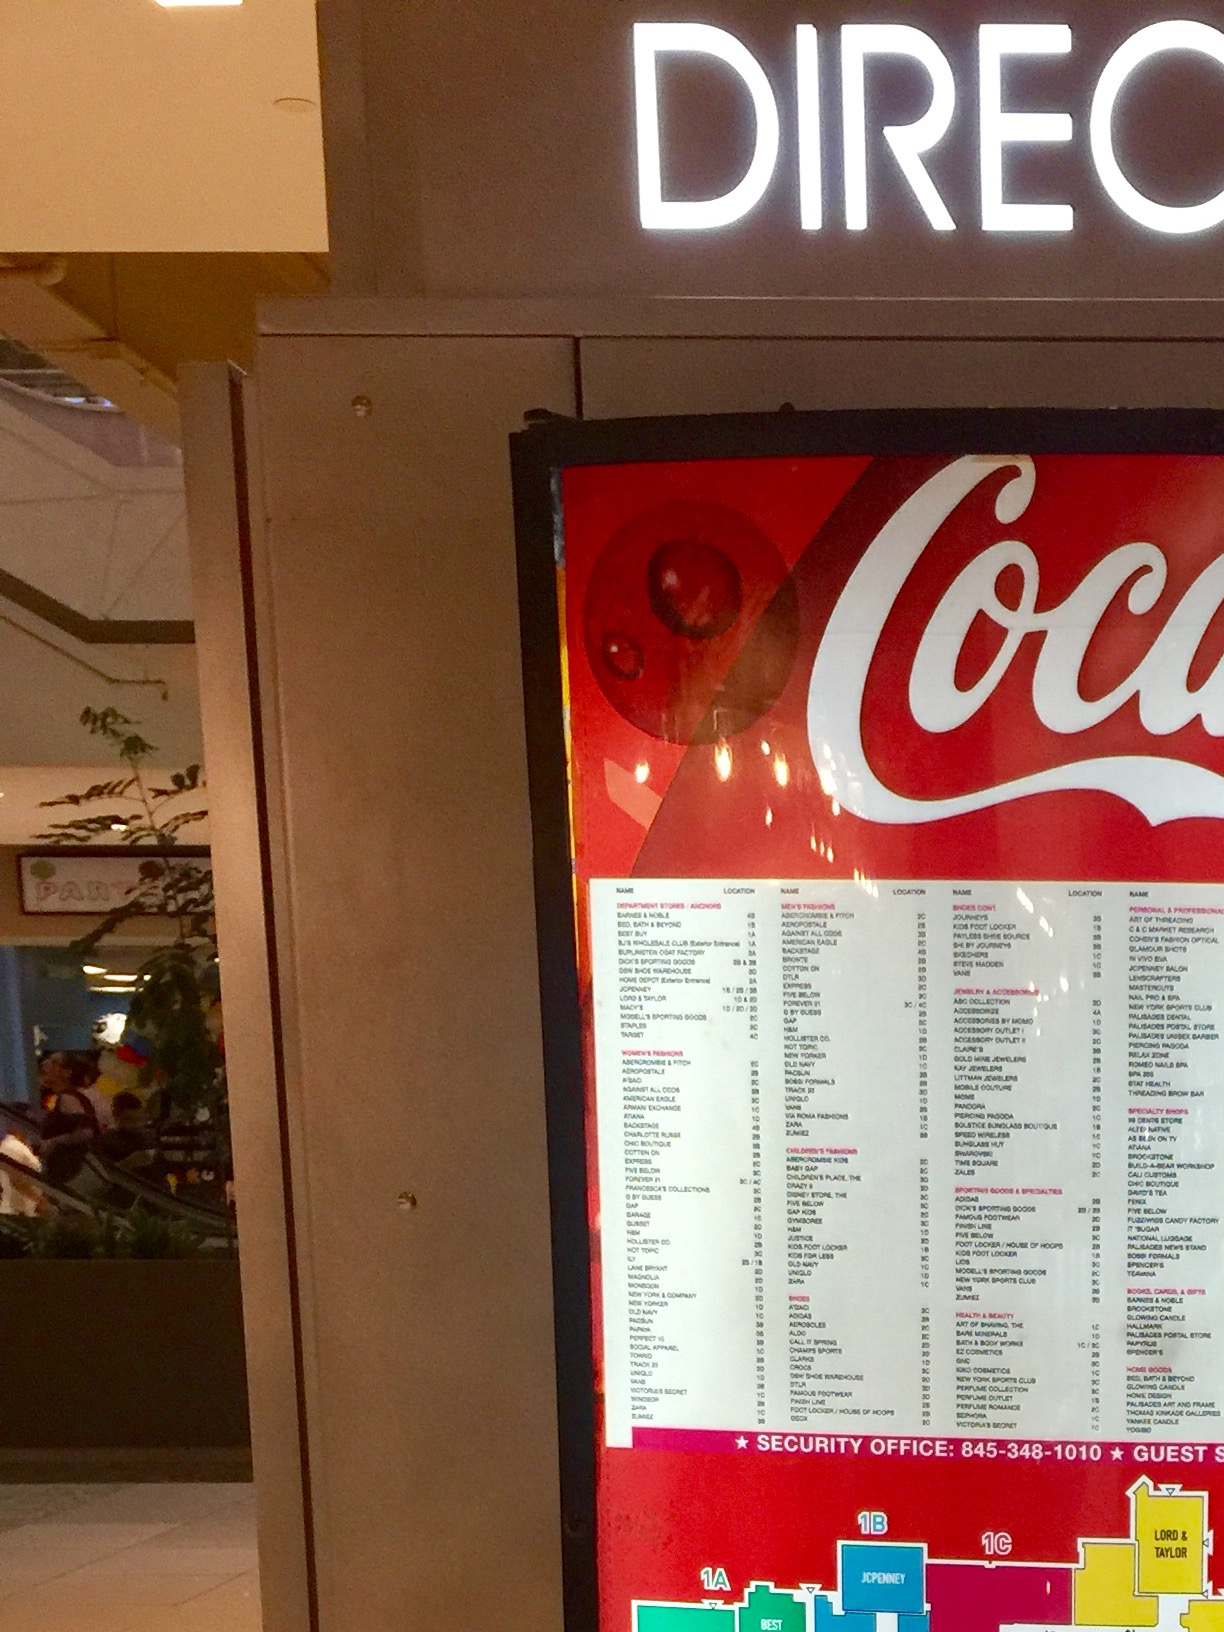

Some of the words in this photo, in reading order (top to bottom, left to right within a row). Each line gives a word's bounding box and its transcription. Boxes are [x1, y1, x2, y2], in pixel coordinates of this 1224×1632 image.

[757, 1435, 862, 1455] SECURITY
[870, 1438, 955, 1457] OFFICE:
[961, 1441, 1101, 1461] 845-348-1010
[1133, 1445, 1208, 1462] GUEST
[859, 1513, 886, 1533] 1B
[982, 1533, 1012, 1554] 1C
[1154, 1530, 1178, 1542] LORD
[1181, 1531, 1188, 1542] &
[1155, 1547, 1188, 1559] TAYLOR
[702, 1568, 730, 1589] 1A
[861, 1572, 905, 1584] JCPENNEY
[761, 1619, 782, 1631] BEST
